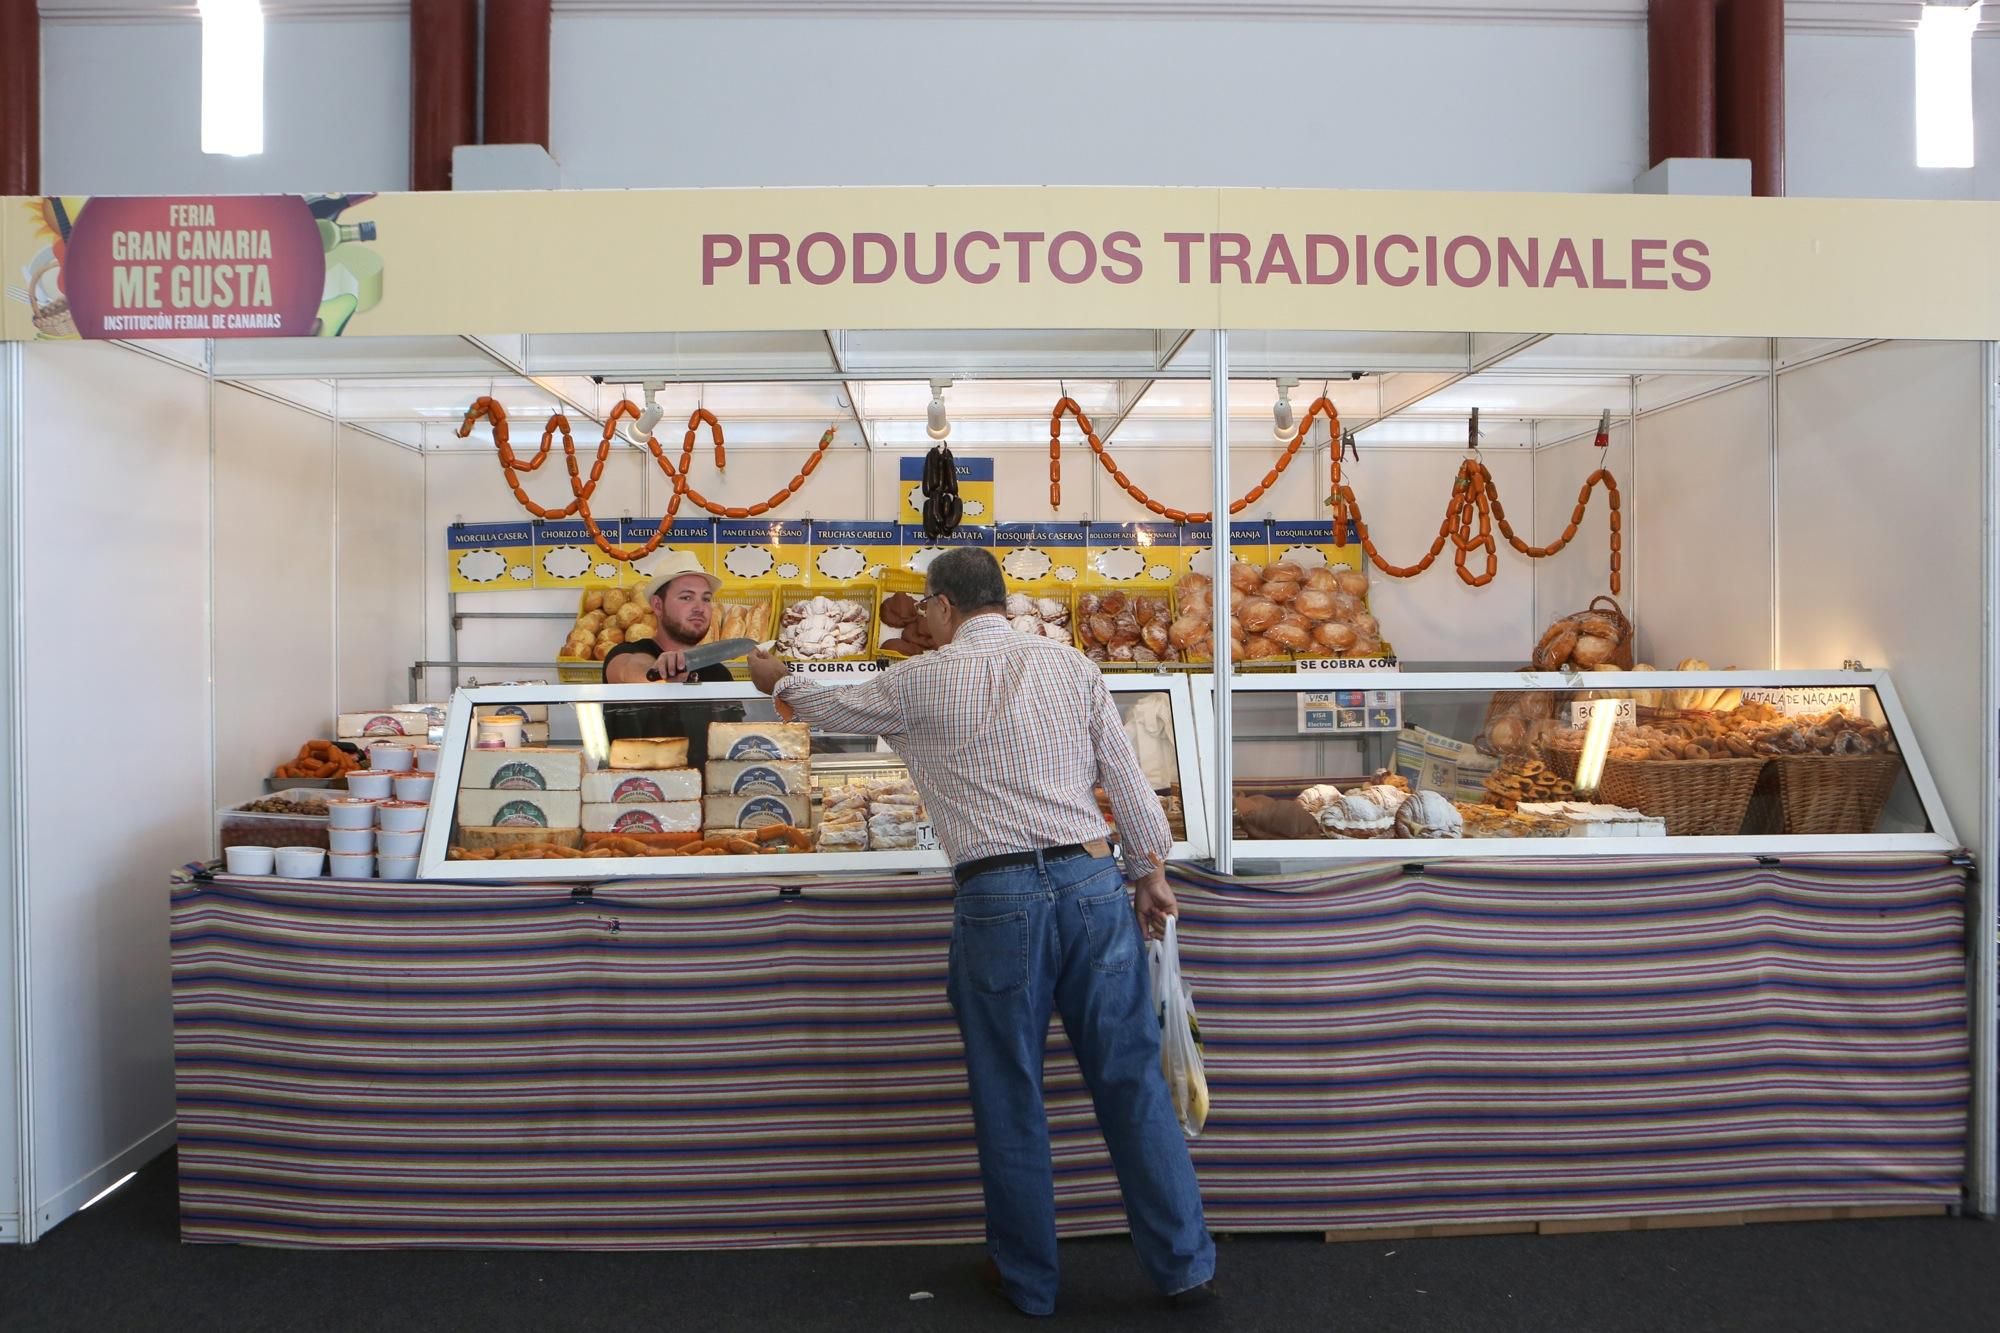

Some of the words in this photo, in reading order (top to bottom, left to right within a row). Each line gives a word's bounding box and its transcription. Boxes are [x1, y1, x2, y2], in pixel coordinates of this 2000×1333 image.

[170, 205, 216, 226] FERIA
[112, 231, 171, 260] GRAN
[177, 230, 272, 260] CANARIA
[702, 231, 1142, 285] PRODUCTOS
[1165, 232, 1711, 291] TRADICIONALES
[113, 266, 162, 308] ME
[171, 264, 272, 308] GUSTA
[104, 312, 172, 330] INSTITUCIÓN
[174, 314, 210, 330] FERIAL
[212, 314, 226, 329] DE
[228, 314, 281, 328] CANARIAS
[456, 534, 496, 542] MORCILLA
[498, 532, 528, 540] CASERA
[541, 530, 578, 538] CHORIZO
[674, 529, 690, 537] DEL
[690, 528, 708, 537] PAÍS
[747, 528, 766, 537] LEÑA
[818, 530, 856, 538] TRUCHAS
[952, 532, 984, 540] BATATA
[997, 532, 1047, 542] ROSQUILLAS
[1048, 532, 1083, 540] CASERAS
[788, 663, 804, 672] SE
[808, 663, 854, 672] COBRA
[858, 663, 886, 672] CON
[1300, 660, 1316, 670] SE
[1321, 660, 1365, 668] COBRA
[1369, 659, 1396, 668] CON
[1787, 694, 1799, 704] DE
[1804, 692, 1856, 706] NARANJA
